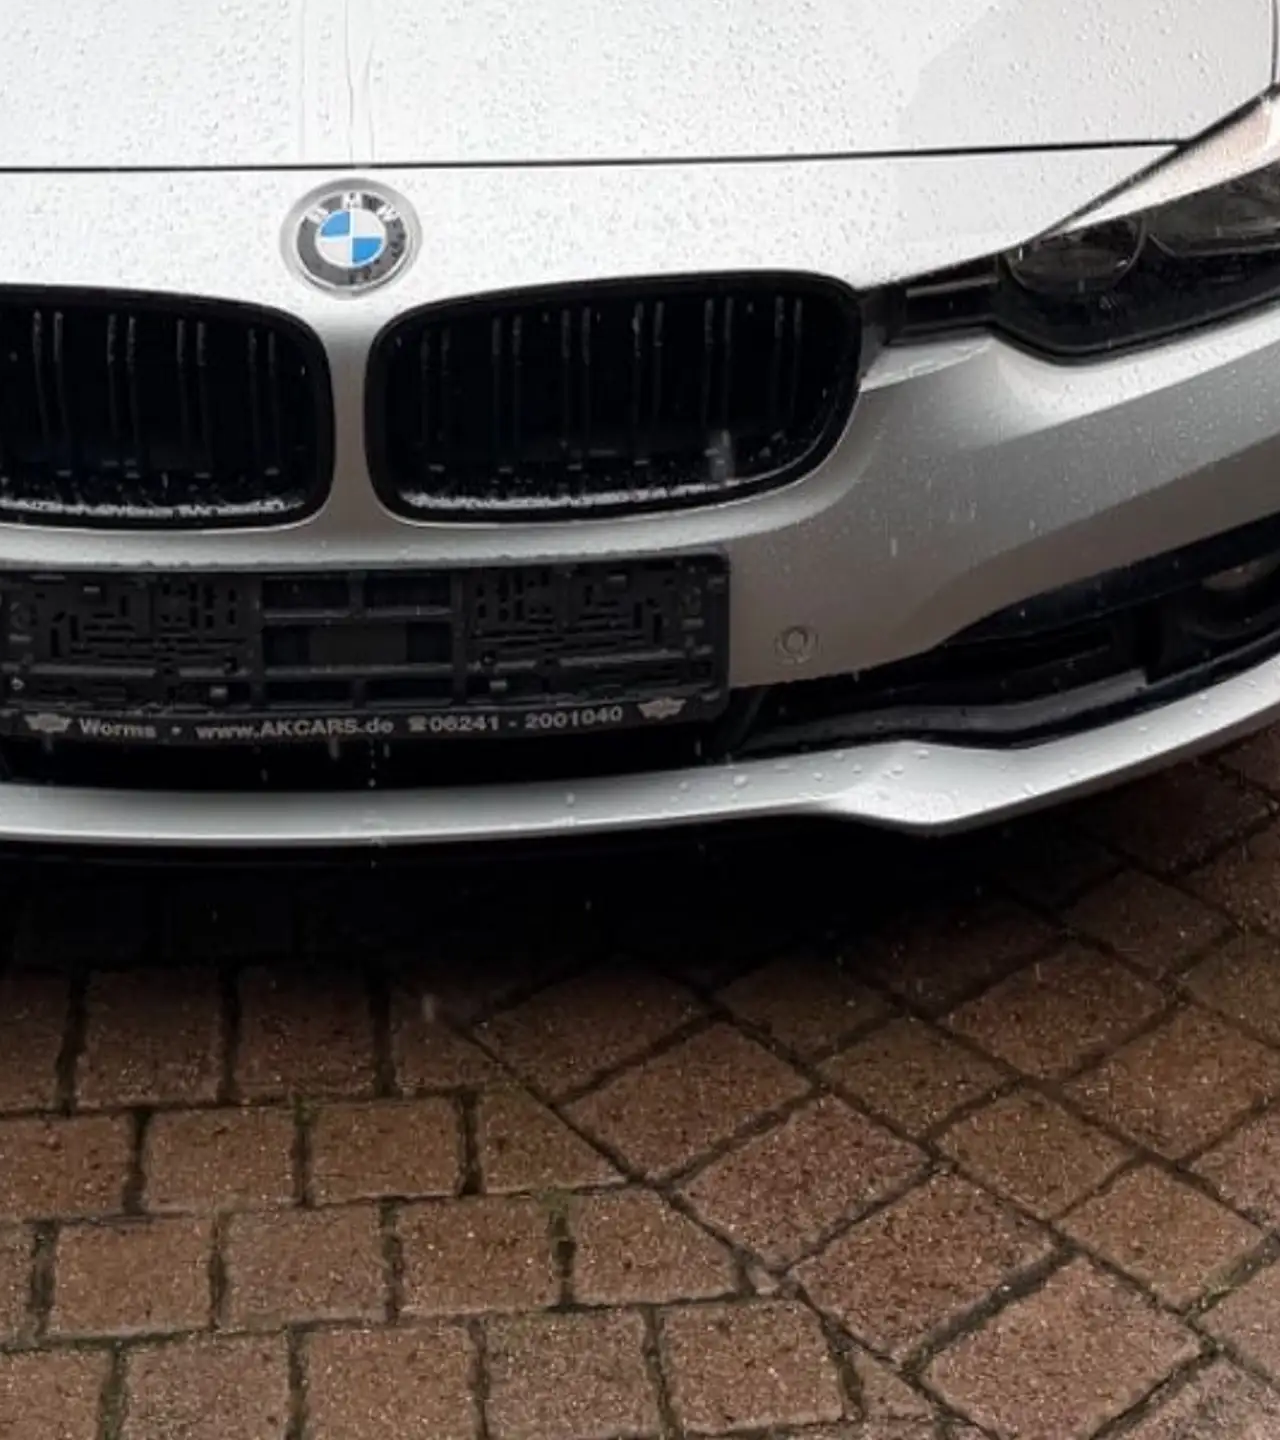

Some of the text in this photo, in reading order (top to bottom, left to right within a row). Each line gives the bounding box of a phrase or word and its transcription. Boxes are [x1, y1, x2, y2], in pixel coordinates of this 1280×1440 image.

[79, 718, 157, 739] Worms
[195, 718, 394, 740] www.AKCARS.de
[524, 706, 624, 730] 2001040
